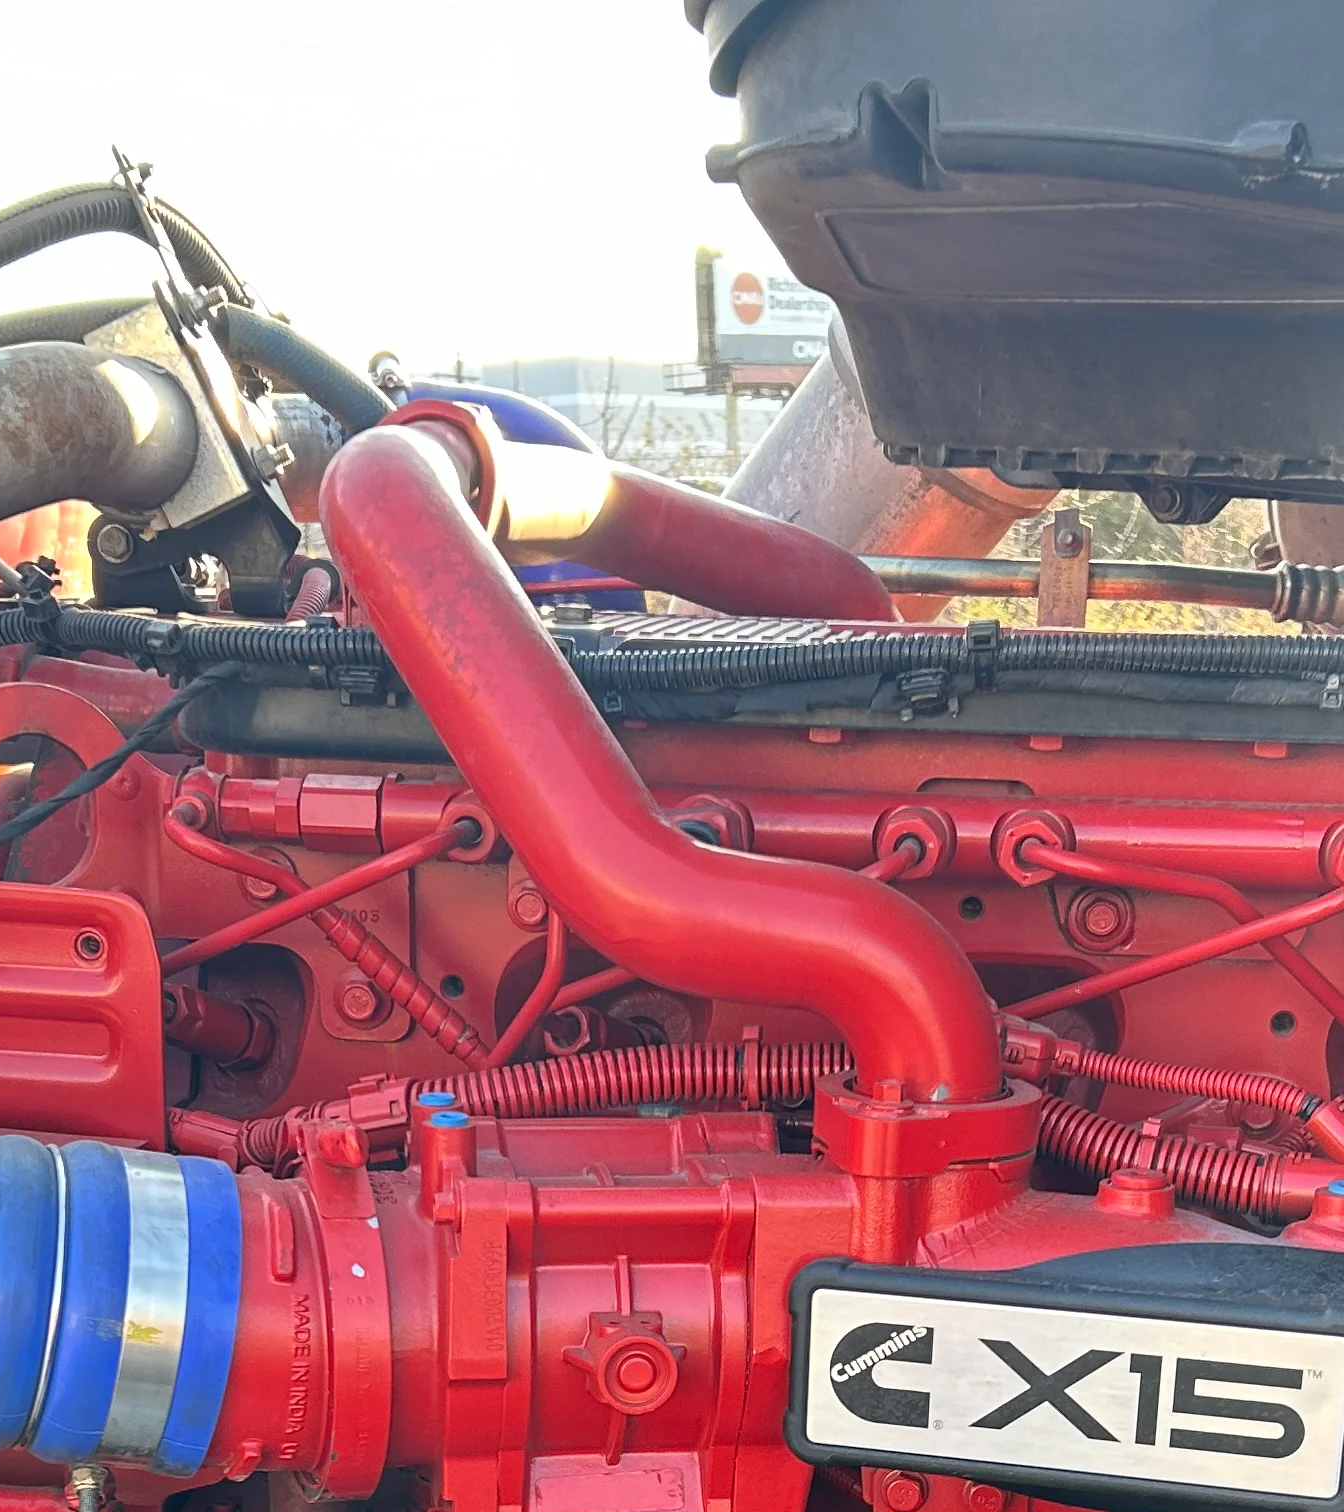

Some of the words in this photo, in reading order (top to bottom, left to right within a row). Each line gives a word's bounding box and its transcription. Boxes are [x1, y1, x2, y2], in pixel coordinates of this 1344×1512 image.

[293, 1293, 312, 1360] MADE
[830, 1323, 928, 1385] Cummins
[290, 1363, 310, 1384] IN
[968, 1337, 1306, 1460] X15
[284, 1386, 309, 1436] INDIA
